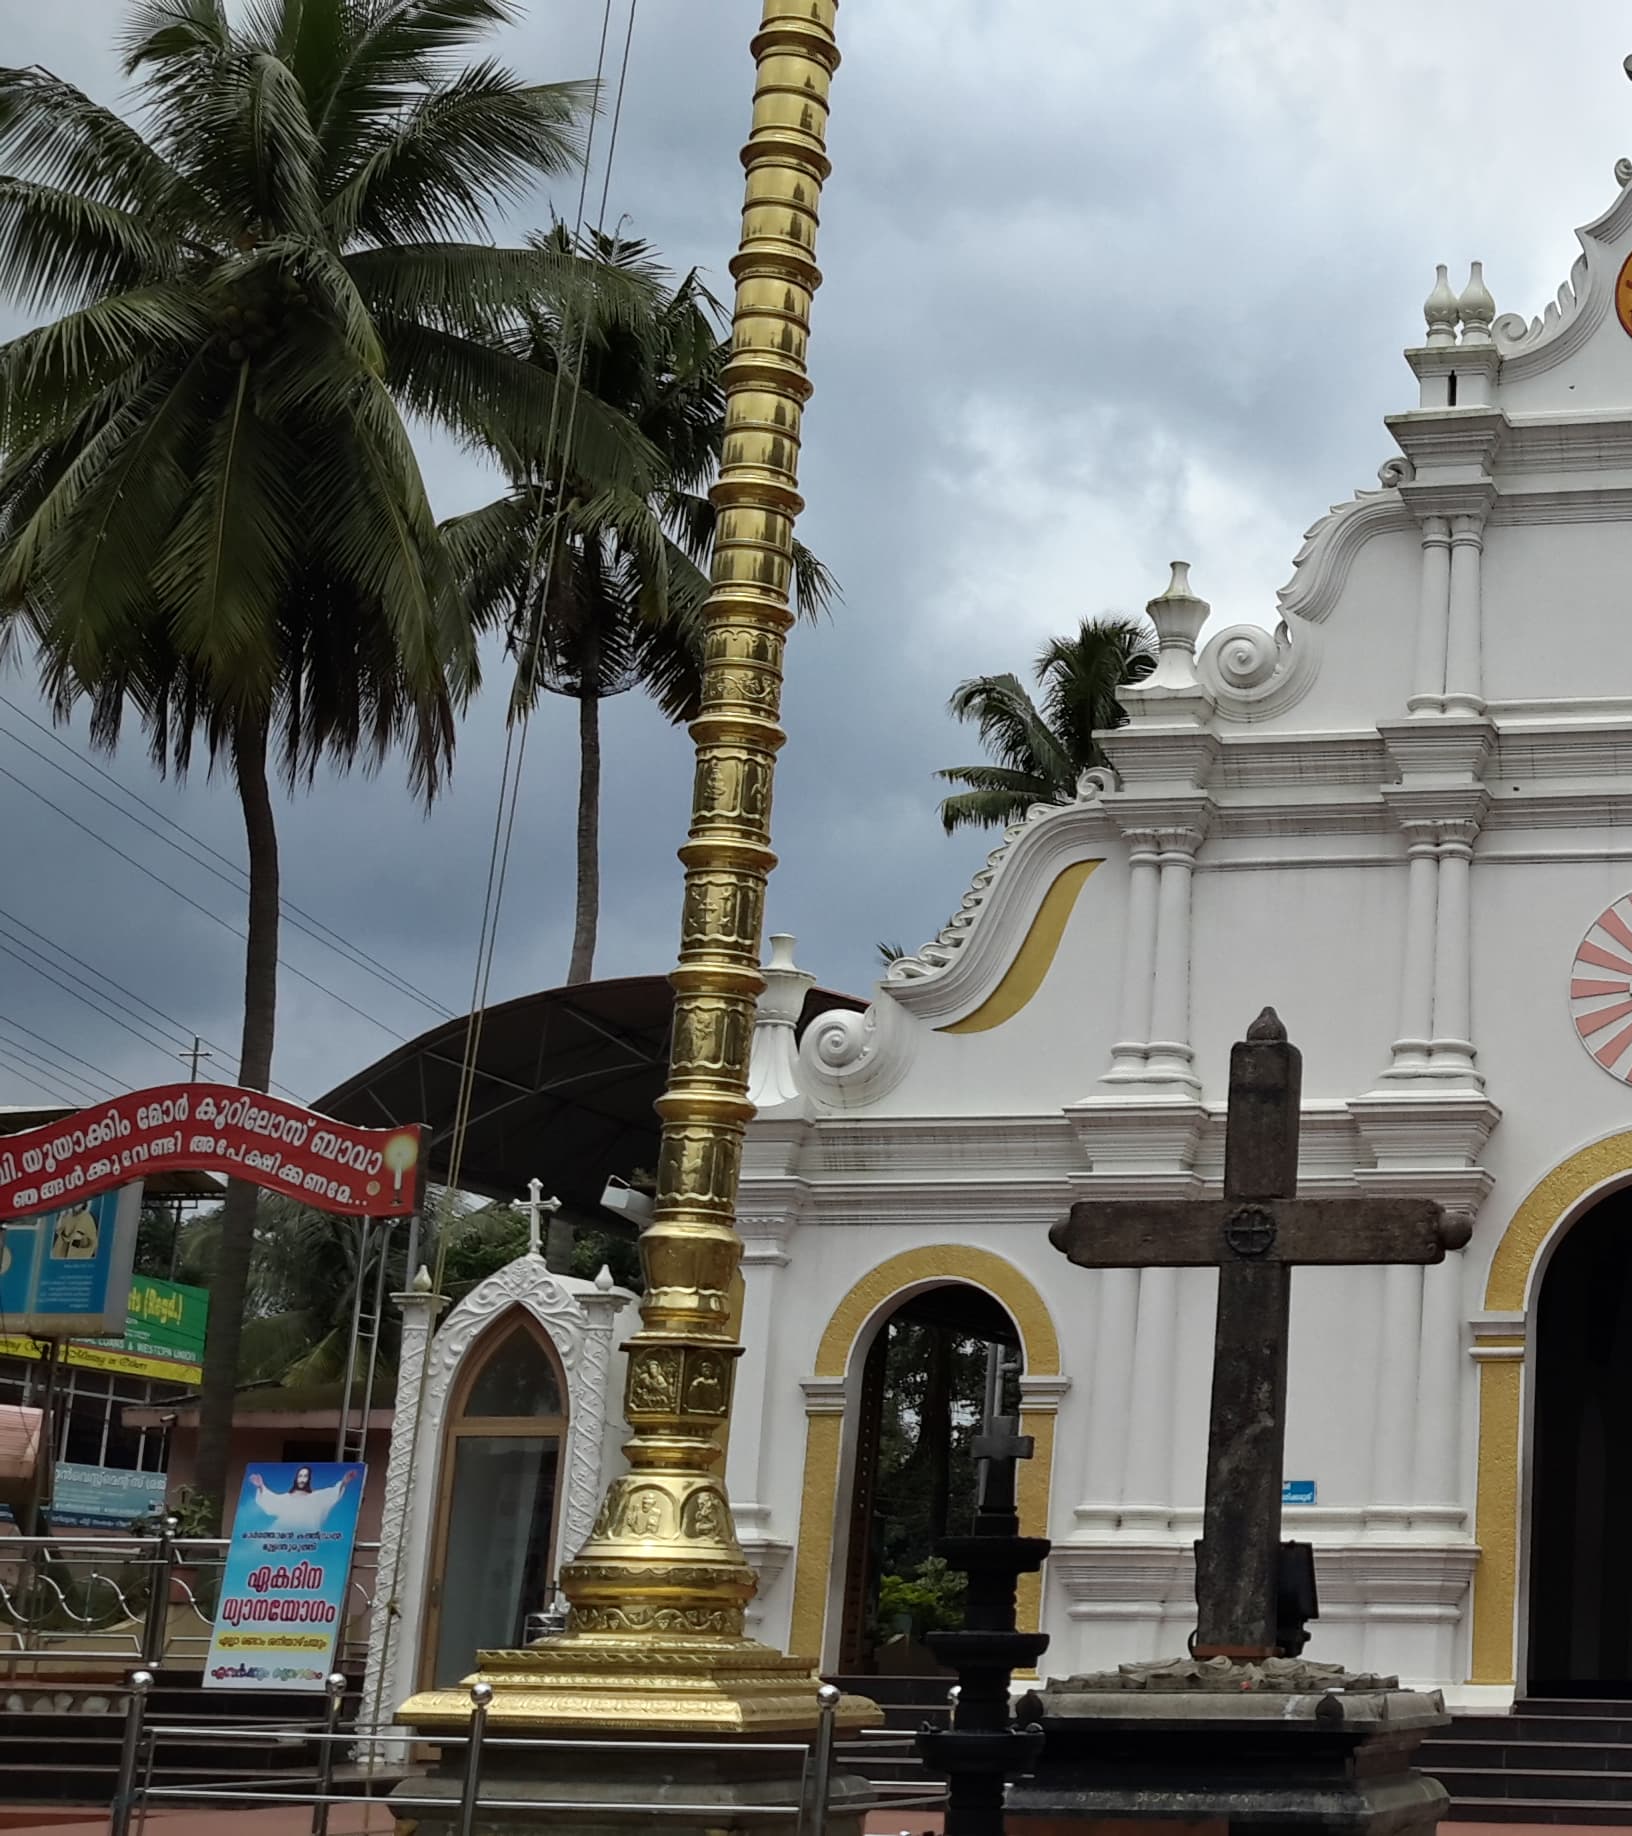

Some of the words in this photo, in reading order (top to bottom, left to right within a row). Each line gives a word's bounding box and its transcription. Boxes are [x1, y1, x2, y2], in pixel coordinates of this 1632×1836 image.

[137, 1092, 189, 1130] മോർ
[310, 1130, 383, 1176] ബാവാ
[247, 1561, 323, 1593] ഏകദിന
[221, 1597, 337, 1627] ധ്യാനയോഗം
